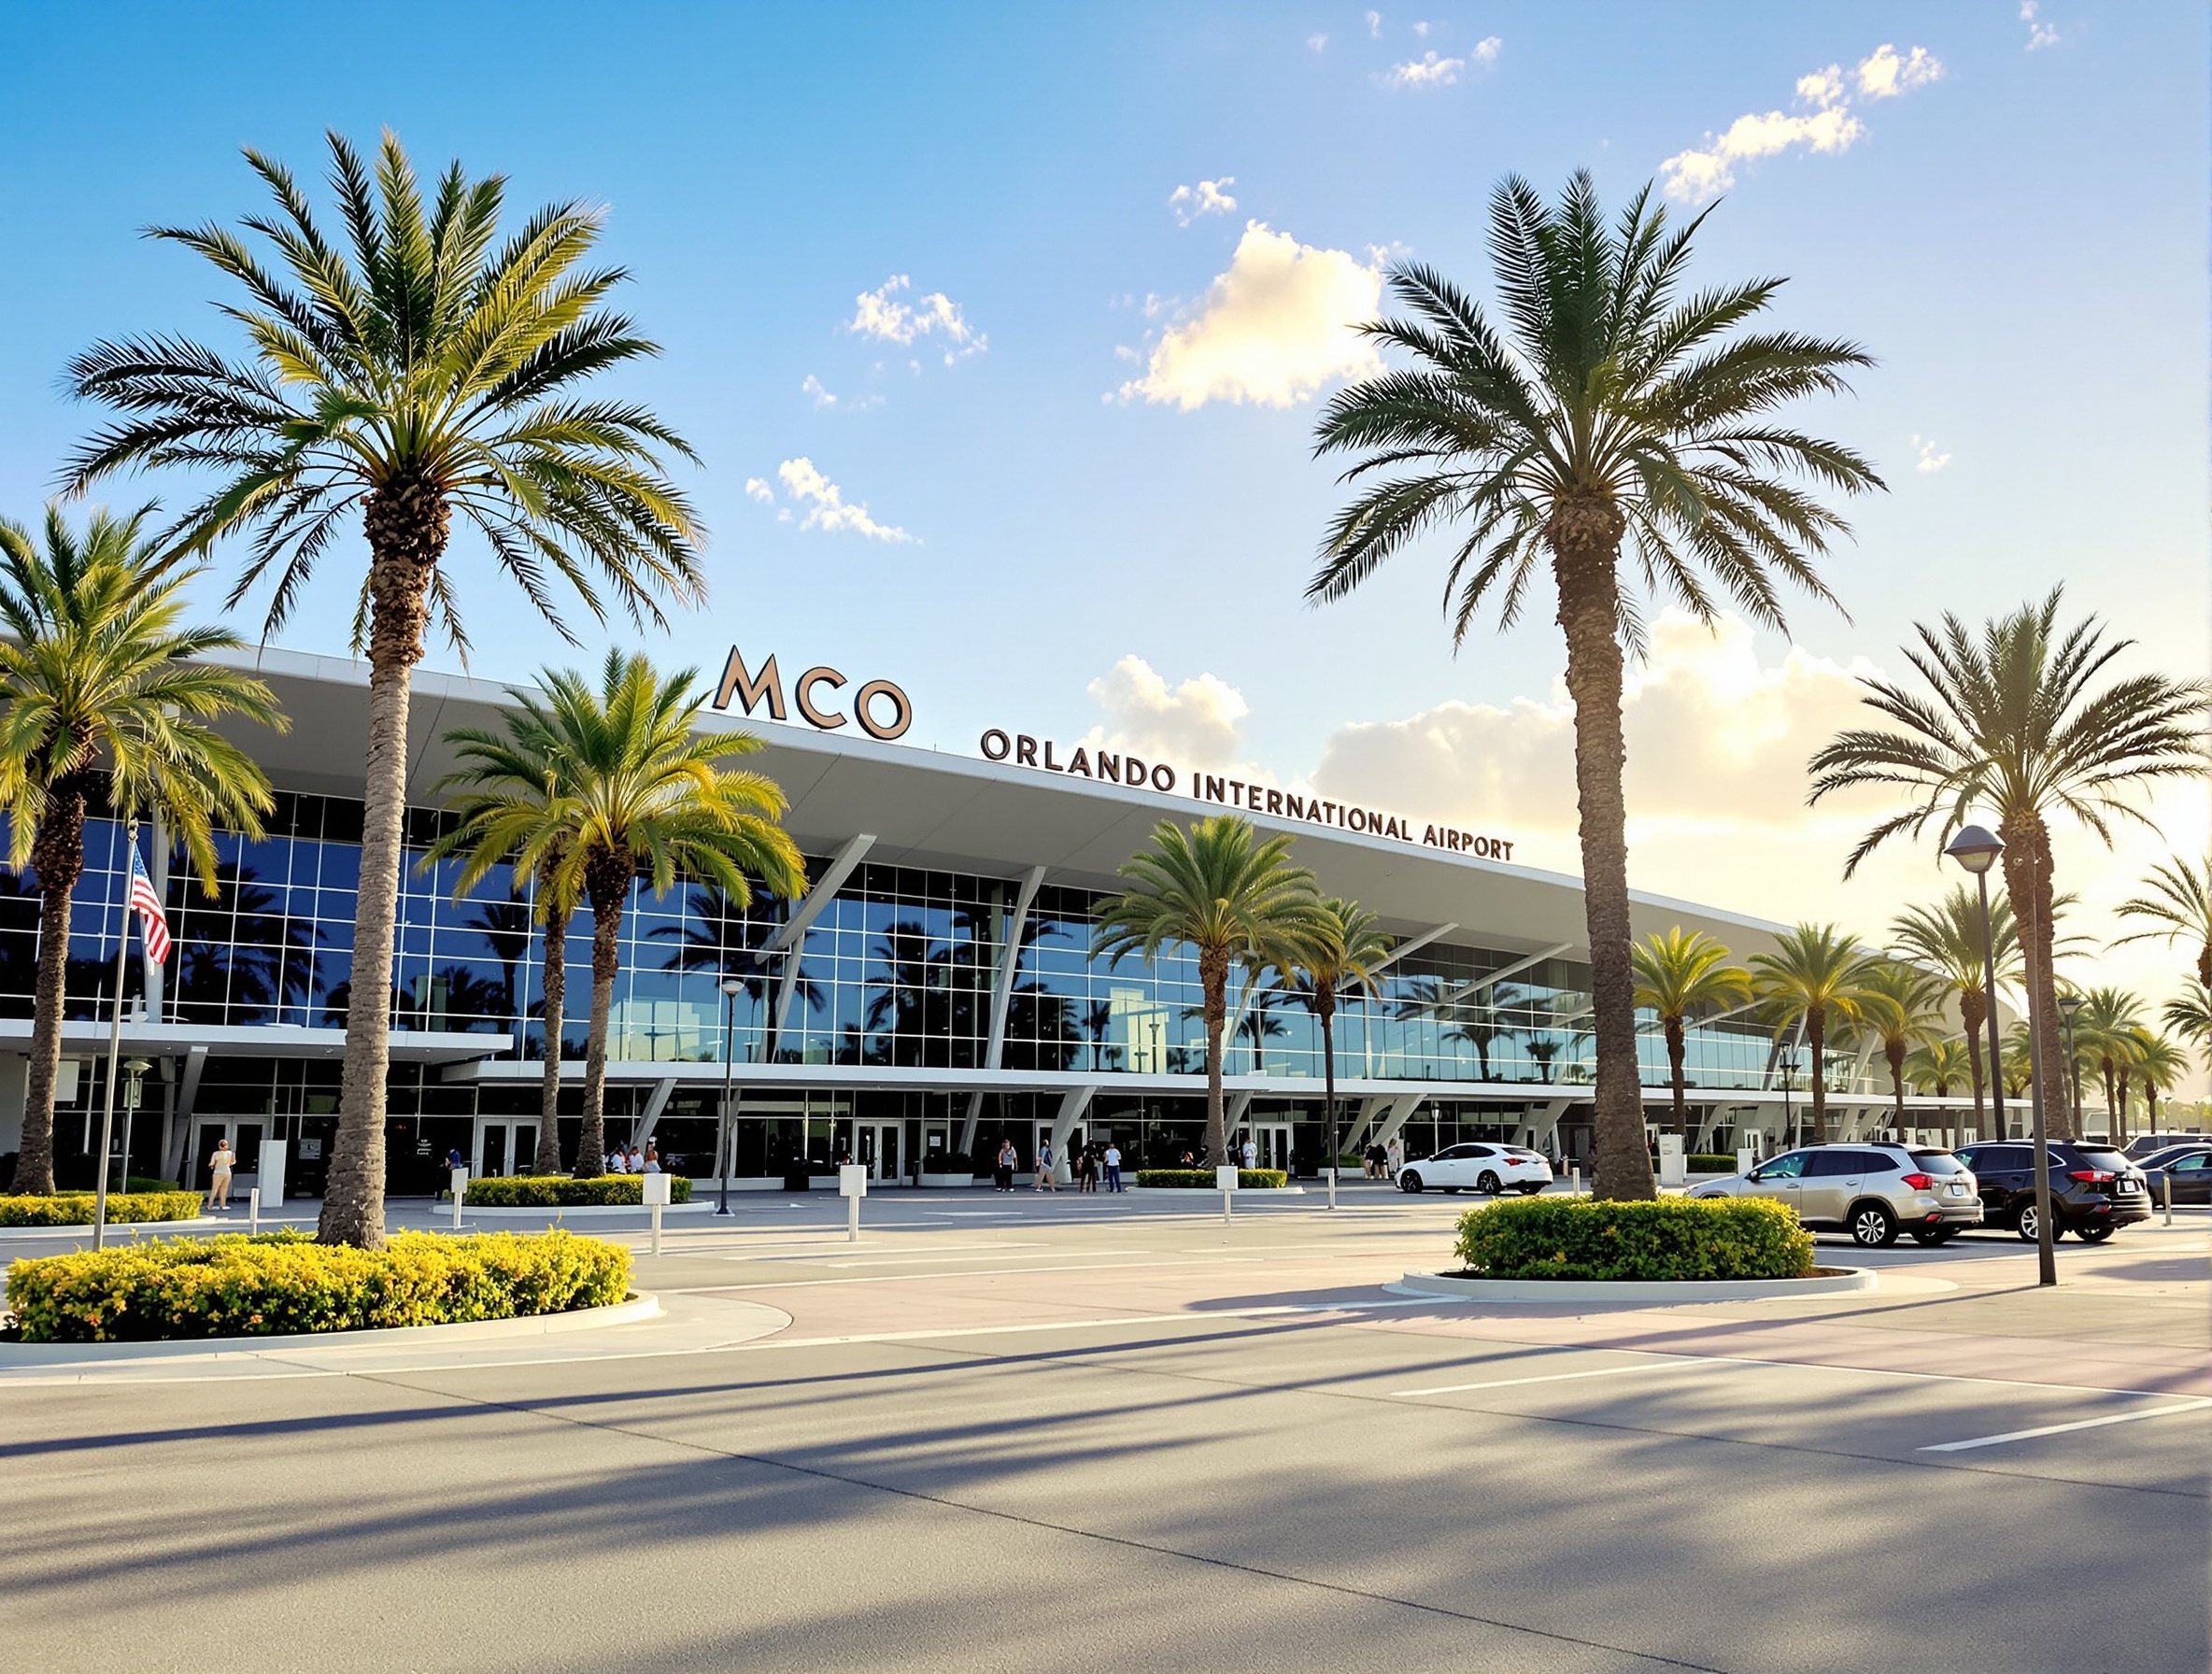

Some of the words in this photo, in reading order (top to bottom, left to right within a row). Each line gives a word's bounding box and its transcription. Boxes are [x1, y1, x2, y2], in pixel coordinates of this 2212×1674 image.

[713, 645, 913, 740] MCO
[981, 729, 1175, 791] ORLANDO
[1194, 773, 1412, 841] INTERNATIONAL
[1423, 824, 1512, 860] AIRPORT
